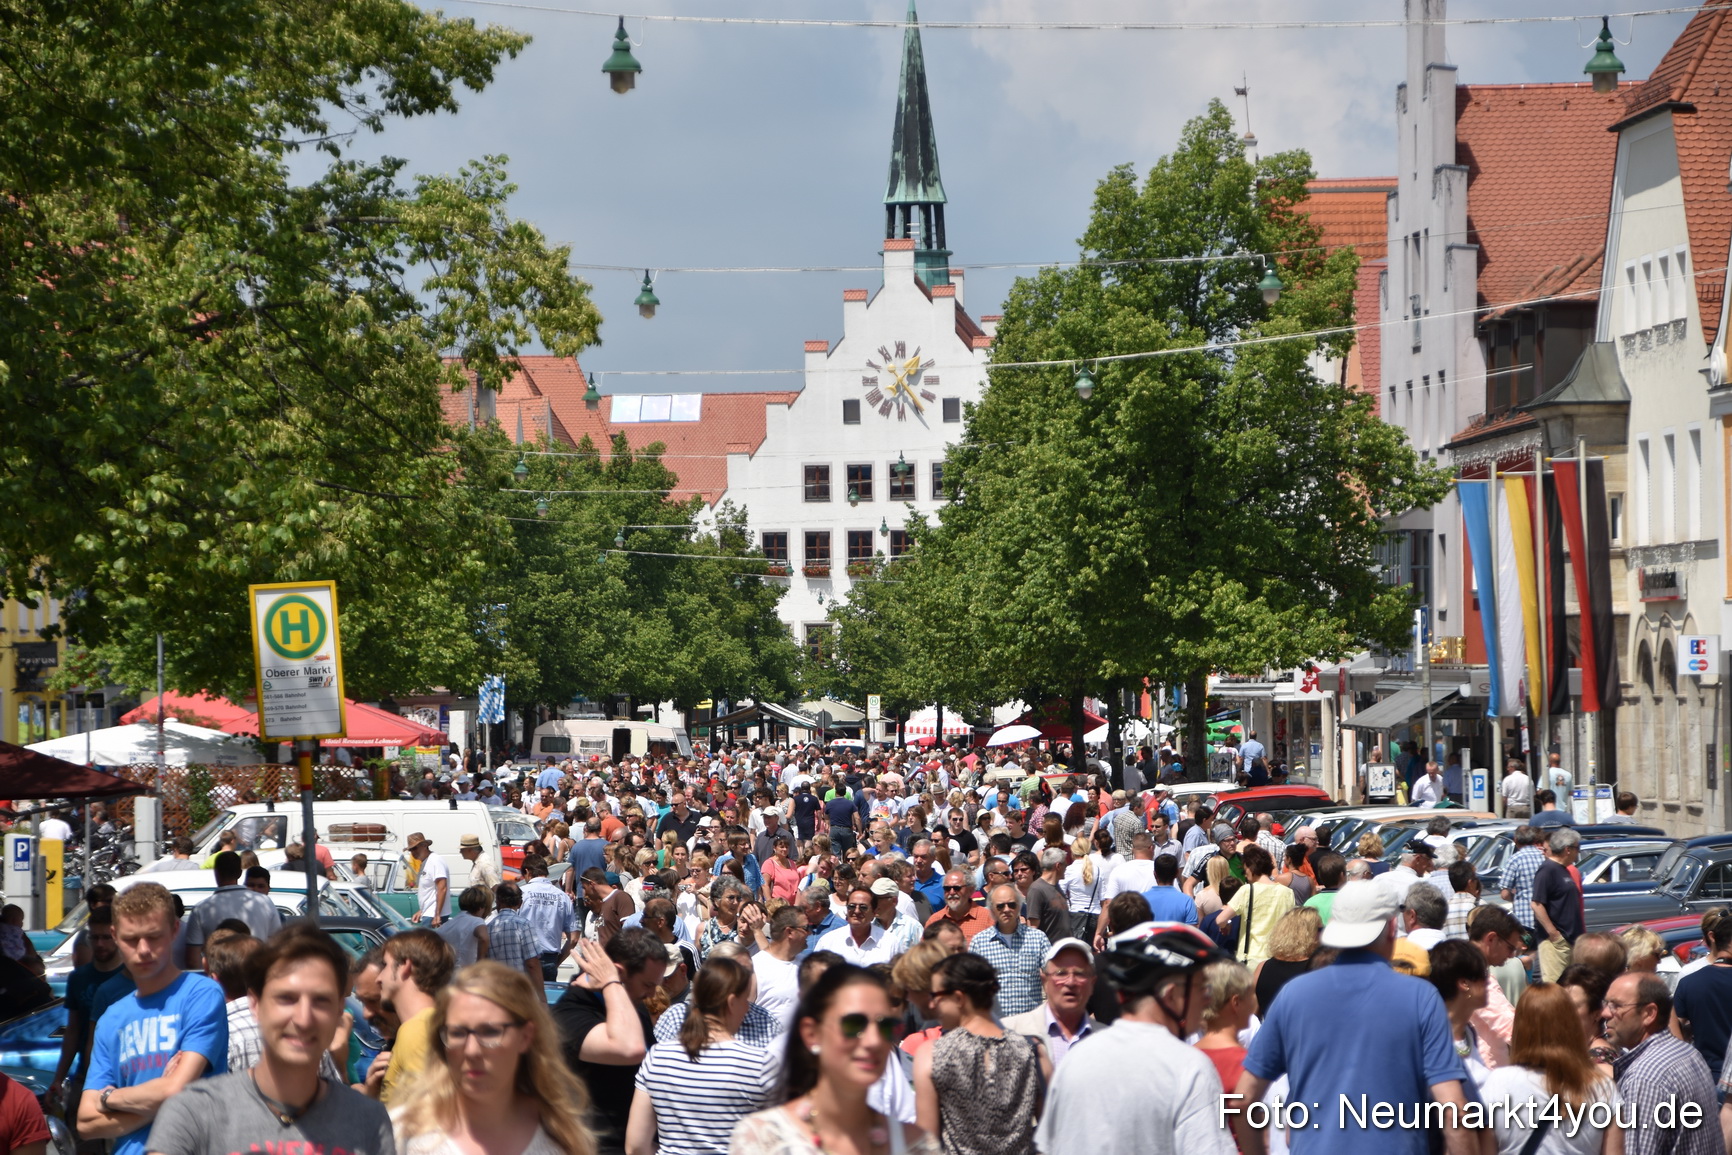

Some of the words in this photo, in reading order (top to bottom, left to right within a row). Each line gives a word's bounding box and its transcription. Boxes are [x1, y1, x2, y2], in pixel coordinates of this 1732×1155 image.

[279, 609, 310, 645] H
[265, 668, 300, 678] Oberer
[303, 665, 332, 676] Markt
[1475, 777, 1483, 789] P
[17, 842, 28, 857] P
